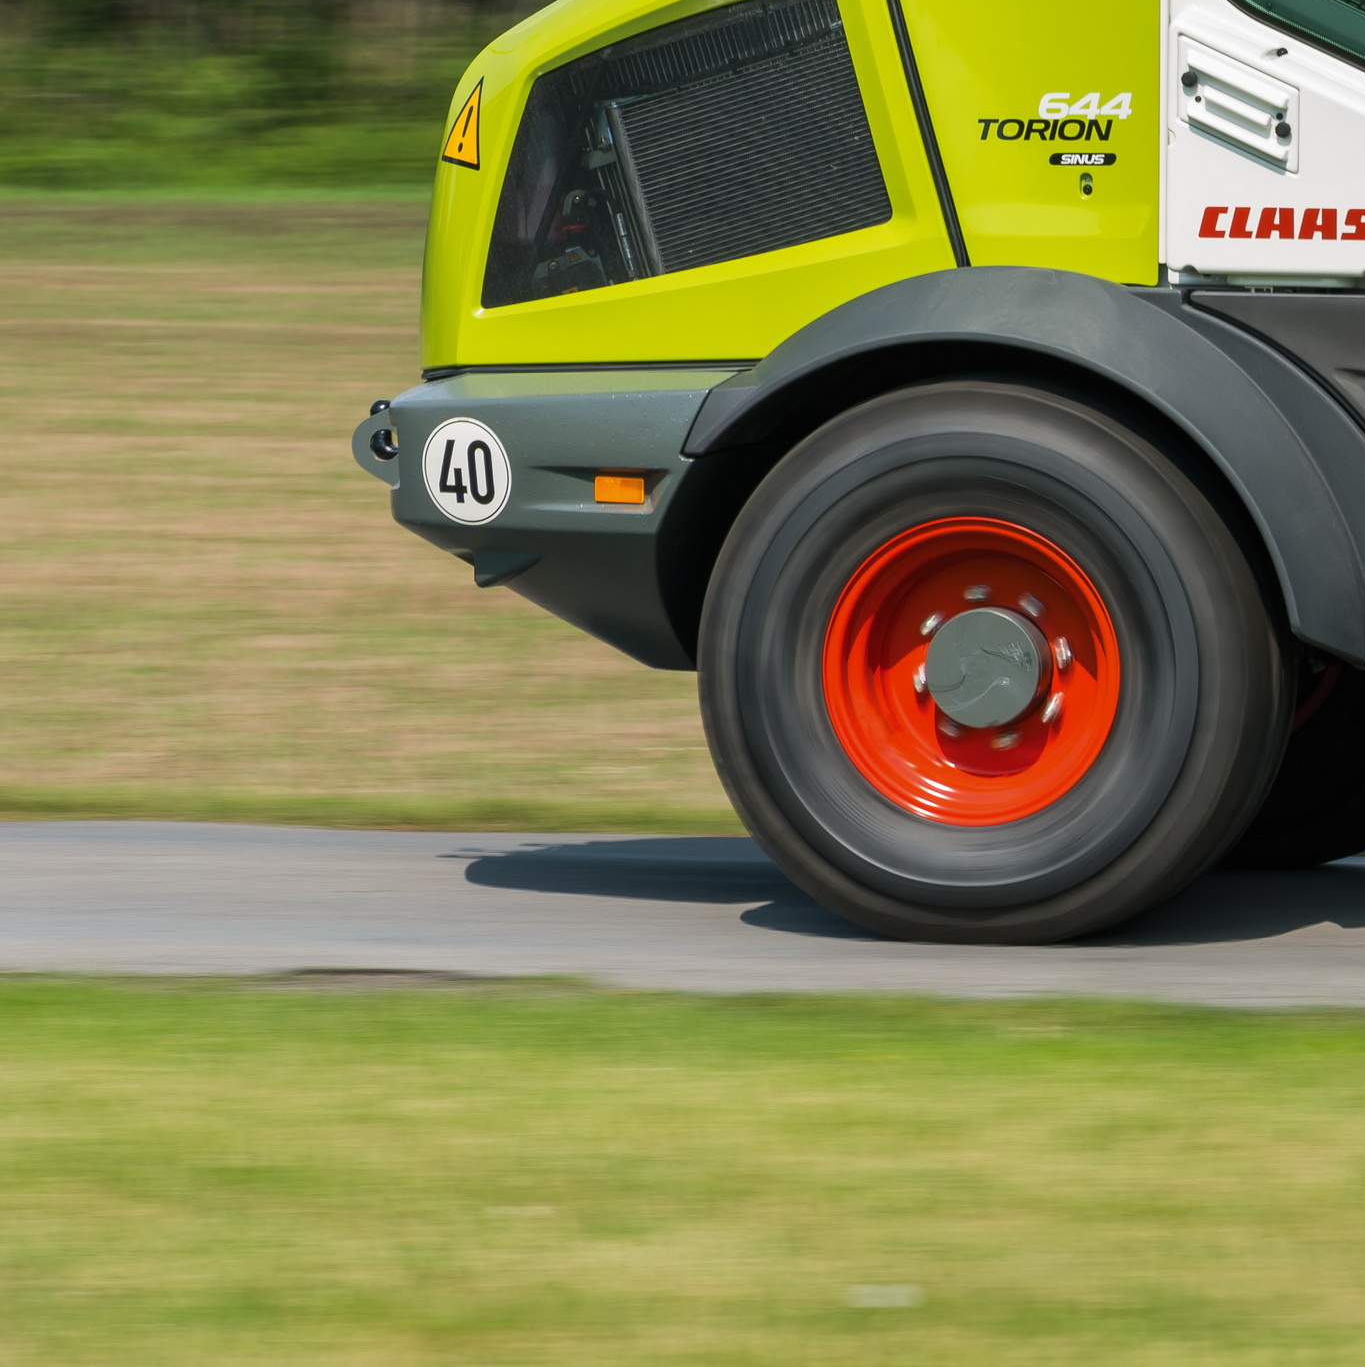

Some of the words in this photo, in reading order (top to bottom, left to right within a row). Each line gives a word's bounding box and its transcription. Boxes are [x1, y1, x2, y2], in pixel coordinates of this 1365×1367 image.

[1038, 92, 1132, 120] 644
[978, 119, 1113, 141] TORION
[1060, 153, 1106, 165] SINUS
[439, 439, 495, 505] 40
